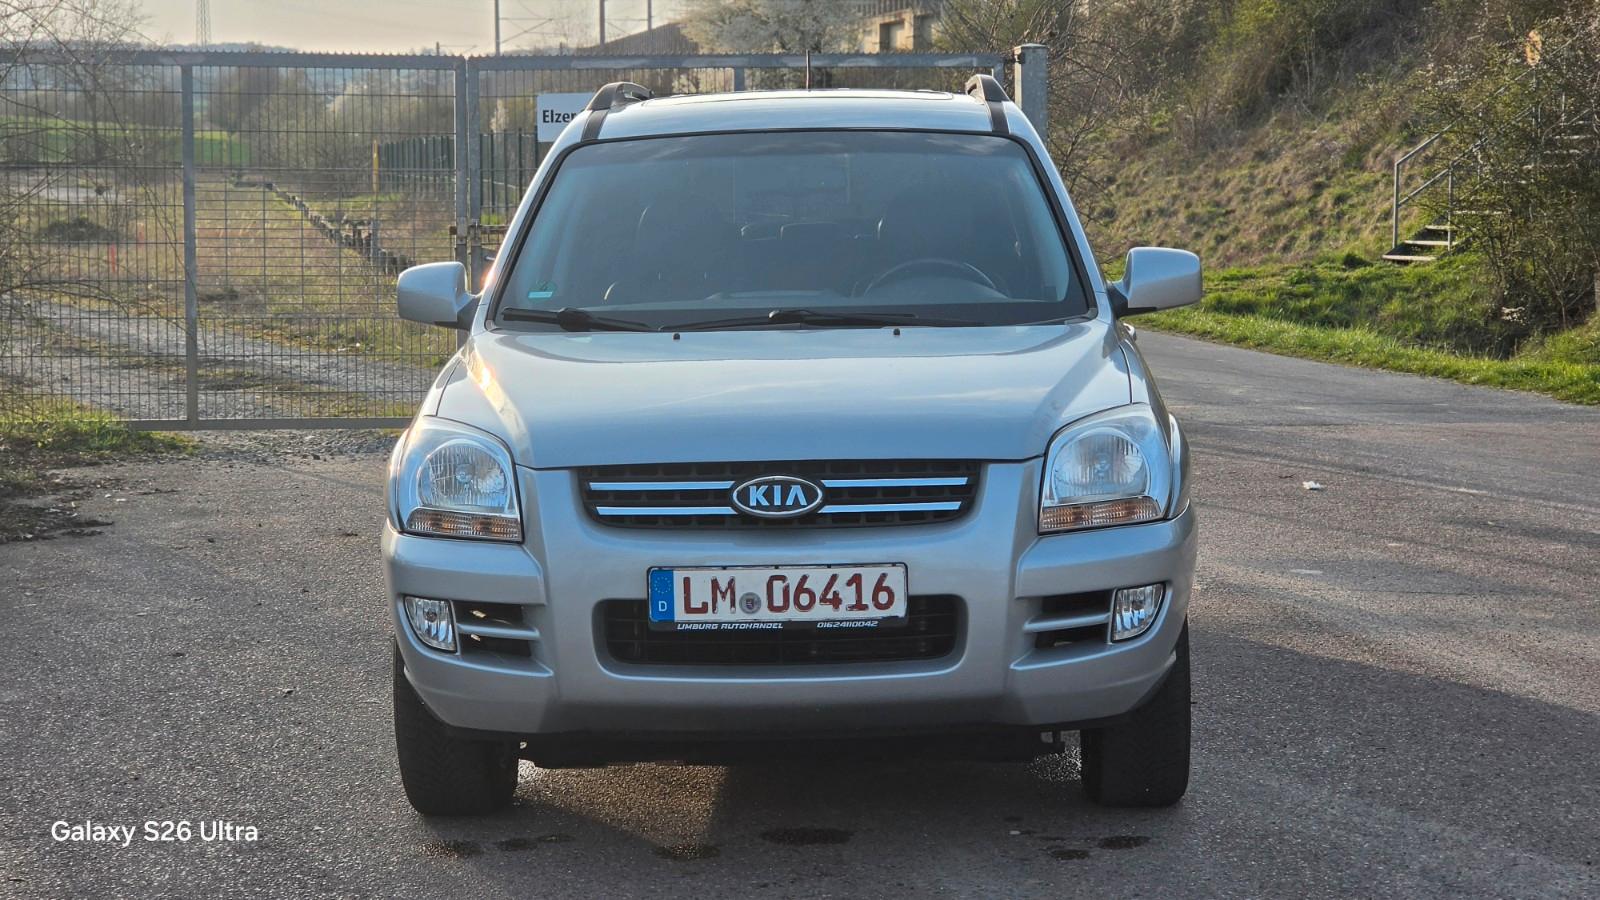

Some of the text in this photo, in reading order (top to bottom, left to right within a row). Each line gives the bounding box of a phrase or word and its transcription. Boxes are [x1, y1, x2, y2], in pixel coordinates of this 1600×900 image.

[749, 484, 808, 507] KIA
[682, 572, 896, 615] LM 06416
[658, 600, 668, 612] D
[677, 622, 784, 631] LIMBURG AUTOHANDEL
